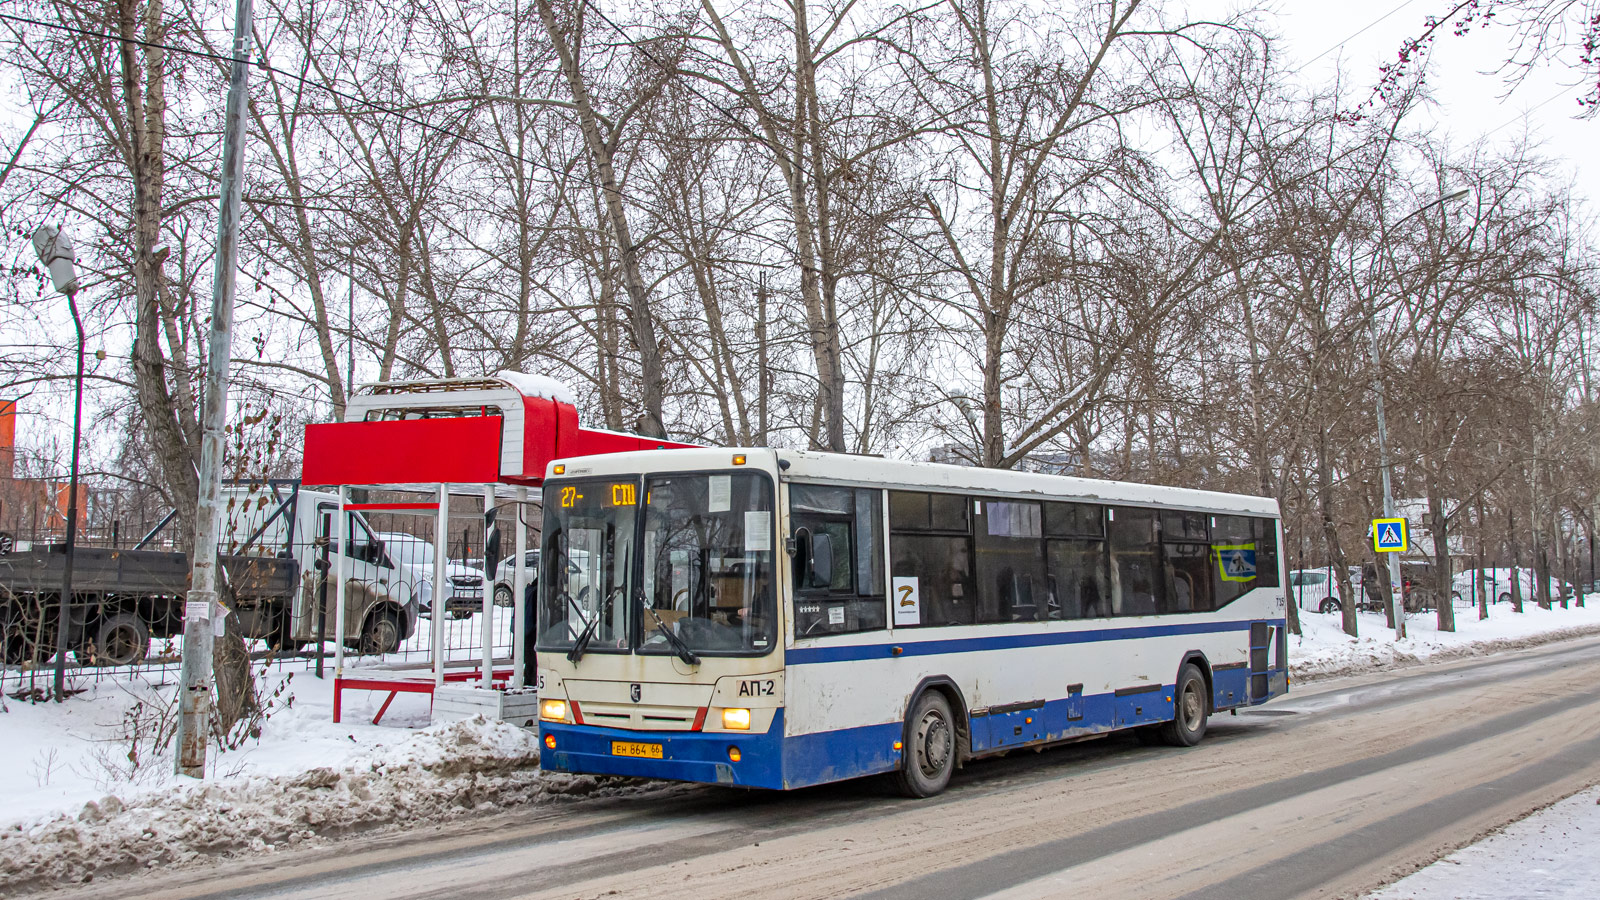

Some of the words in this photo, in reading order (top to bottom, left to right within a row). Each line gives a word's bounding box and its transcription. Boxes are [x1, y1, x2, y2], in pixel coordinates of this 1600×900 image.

[739, 680, 775, 696] АП-2
[630, 744, 646, 755] 864
[650, 744, 660, 754] 66
